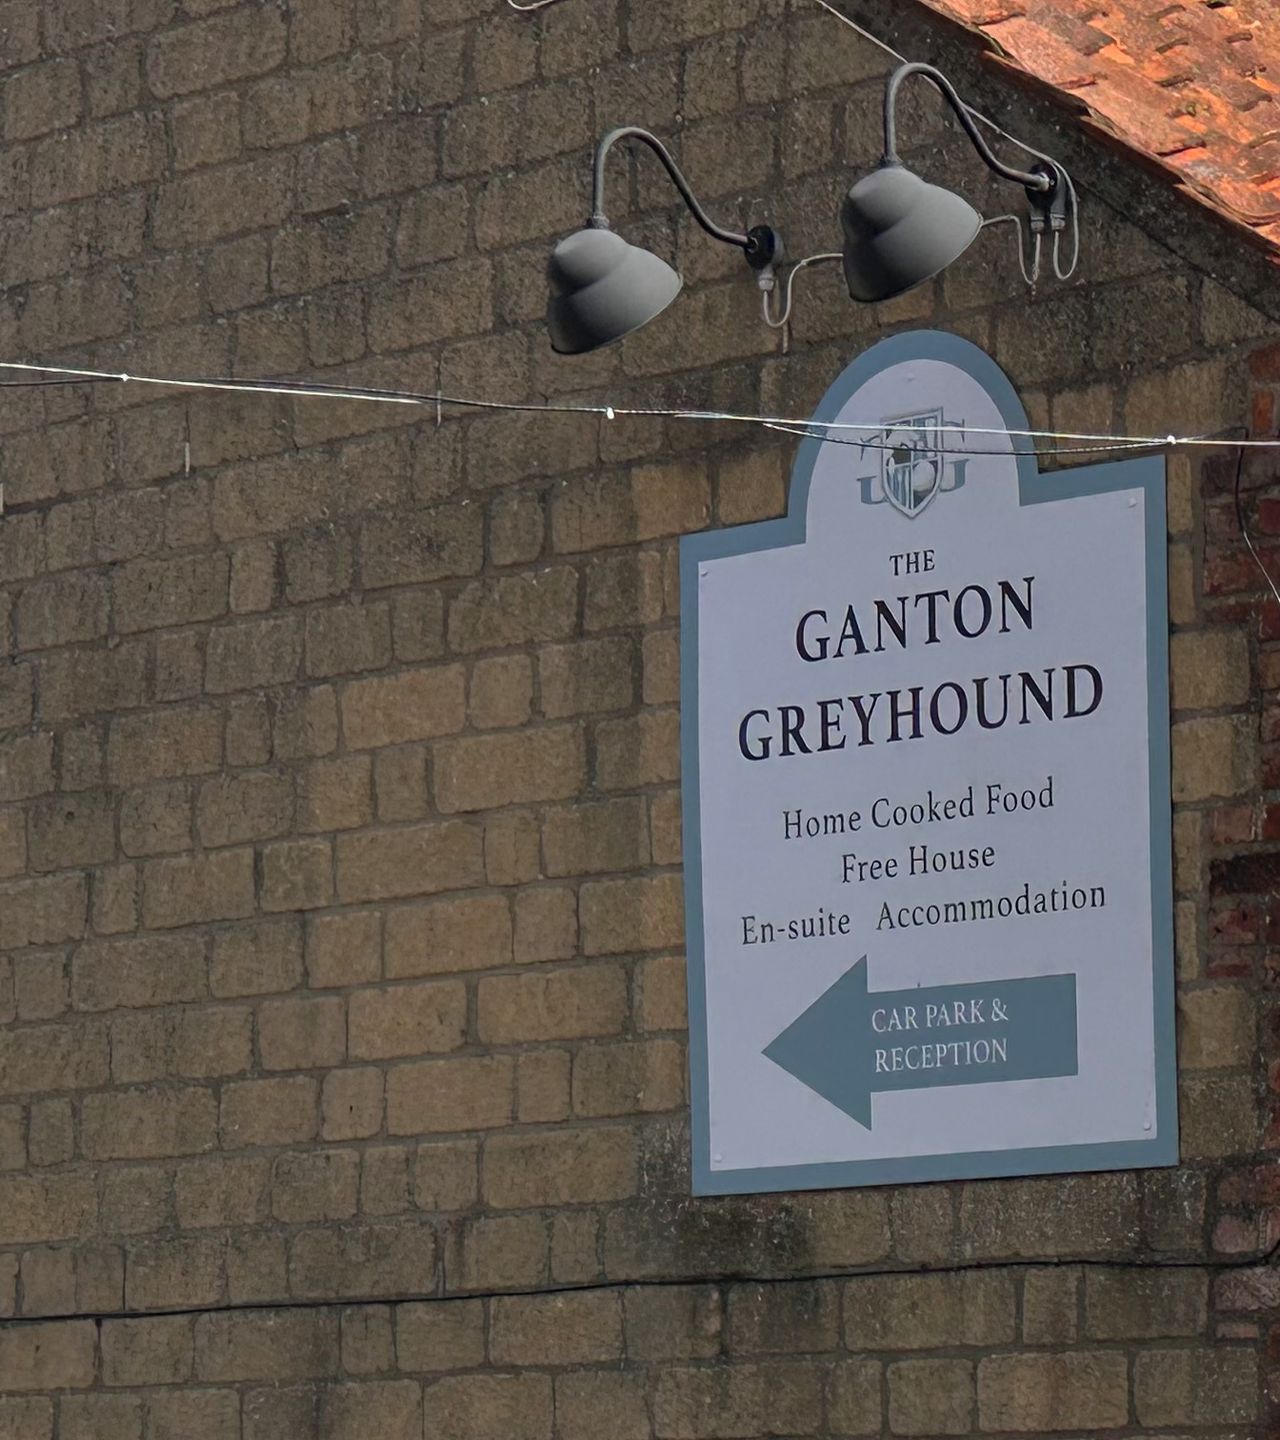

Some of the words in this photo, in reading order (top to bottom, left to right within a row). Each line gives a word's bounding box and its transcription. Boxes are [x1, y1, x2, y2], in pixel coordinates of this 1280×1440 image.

[889, 549, 936, 576] THE
[796, 576, 1035, 662] GANTON
[738, 663, 1103, 761] GREYHOUND
[783, 807, 862, 839] Home
[871, 786, 974, 829] Cooked
[986, 776, 1054, 815] Food
[841, 854, 898, 883] Free
[909, 844, 996, 876] House
[741, 908, 851, 945] En-suite
[876, 880, 1105, 930] Accommodation
[871, 1006, 918, 1032] CAR
[926, 999, 985, 1028] PARK
[990, 998, 1009, 1021] &
[875, 1038, 1008, 1073] RECEPTION
